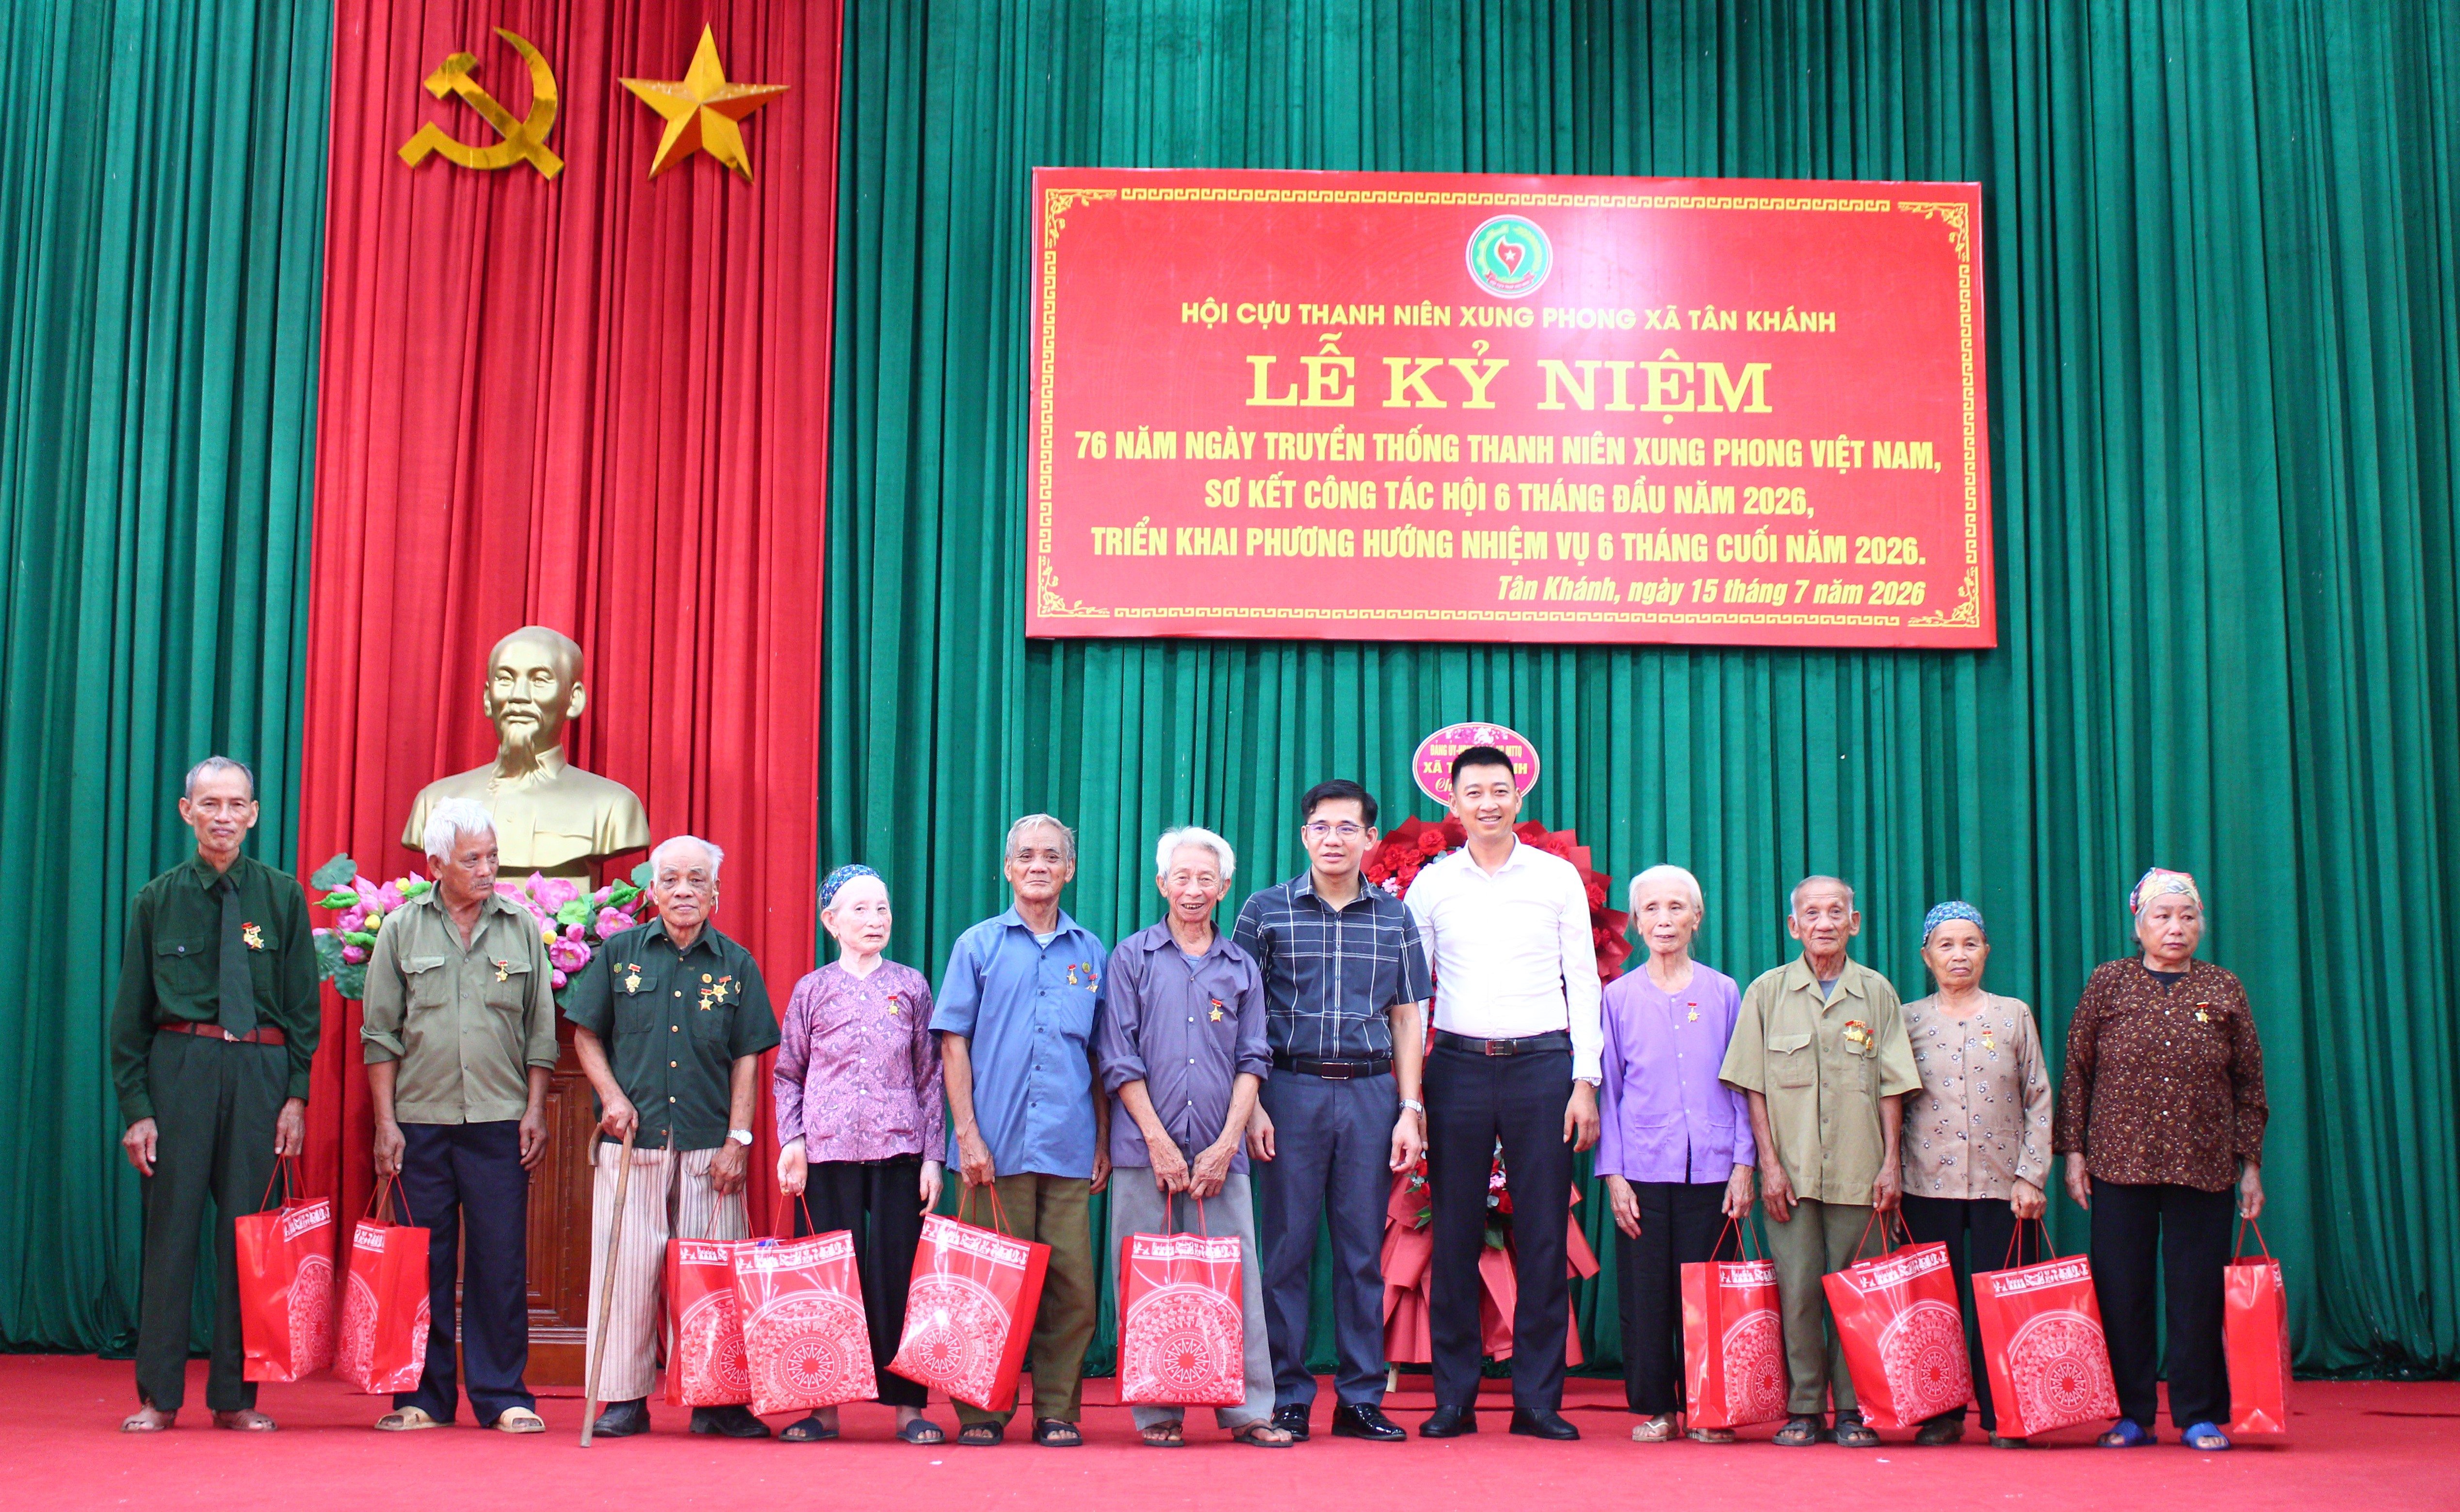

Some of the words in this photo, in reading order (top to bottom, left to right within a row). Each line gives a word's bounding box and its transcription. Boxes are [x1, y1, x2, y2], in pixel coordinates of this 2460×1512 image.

[1182, 297, 1228, 329] HỘI
[1237, 301, 1290, 329] CỰU
[1298, 304, 1384, 325] THANH
[1394, 300, 1450, 326] NIÊN
[1459, 306, 1534, 327] XUNG
[1543, 308, 1636, 329] PHONG
[1645, 305, 1681, 330] XÃ
[1688, 305, 1737, 331] TÂN
[1747, 306, 1835, 332] KHÁNH
[1246, 332, 1355, 407] LỄ
[1383, 340, 1509, 409] KỶ
[1538, 348, 1772, 424] NIỆM
[1075, 431, 1106, 459] 76
[1116, 425, 1176, 459] NĂM
[1186, 426, 1256, 459] NGÀY
[1264, 424, 1364, 461] TRUYỀN
[1373, 424, 1459, 462] THỐNG
[1467, 435, 1554, 464] THANH
[1563, 431, 1625, 465] NIÊN
[1634, 437, 1705, 466] XUNG
[1714, 438, 1802, 467] PHONG
[1810, 434, 1865, 474] VIỆT
[1873, 441, 1941, 473] NAM,
[1205, 477, 1241, 507] SƠ
[1249, 471, 1296, 508] KẾT
[1305, 475, 1376, 509] CÔNG
[1385, 476, 1434, 510] TÁC
[1443, 477, 1486, 516] HỘI
[1495, 483, 1510, 511] 6
[1518, 478, 1604, 512] THÁNG
[1612, 475, 1665, 514] ĐẦU
[1674, 480, 1734, 514] NĂM
[1743, 486, 1814, 518] 2026,
[1091, 516, 1167, 556] TRIỂN
[1177, 528, 1237, 555] KHAI
[1247, 526, 1354, 557] PHƯƠNG
[1363, 524, 1453, 558] HƯỚNG
[1462, 525, 1547, 565] NHIỆM
[1556, 532, 1589, 566] VỤ
[1598, 533, 1613, 561] 6
[1621, 528, 1708, 562] THÁNG
[1717, 525, 1777, 563] CUỐI
[1786, 529, 1846, 563] NĂM
[1855, 536, 1926, 565] 2026.
[1498, 576, 1539, 601] Tân
[1543, 576, 1620, 605] Khánh,
[1628, 578, 1684, 606] ngày
[1692, 579, 1719, 603] 15
[1723, 578, 1788, 606] tháng
[1794, 580, 1810, 603] 7
[1813, 579, 1863, 604] năm
[1868, 581, 1926, 605] 2026
[1423, 759, 1442, 773] XÃ
[1506, 745, 1522, 757] MTTQ
